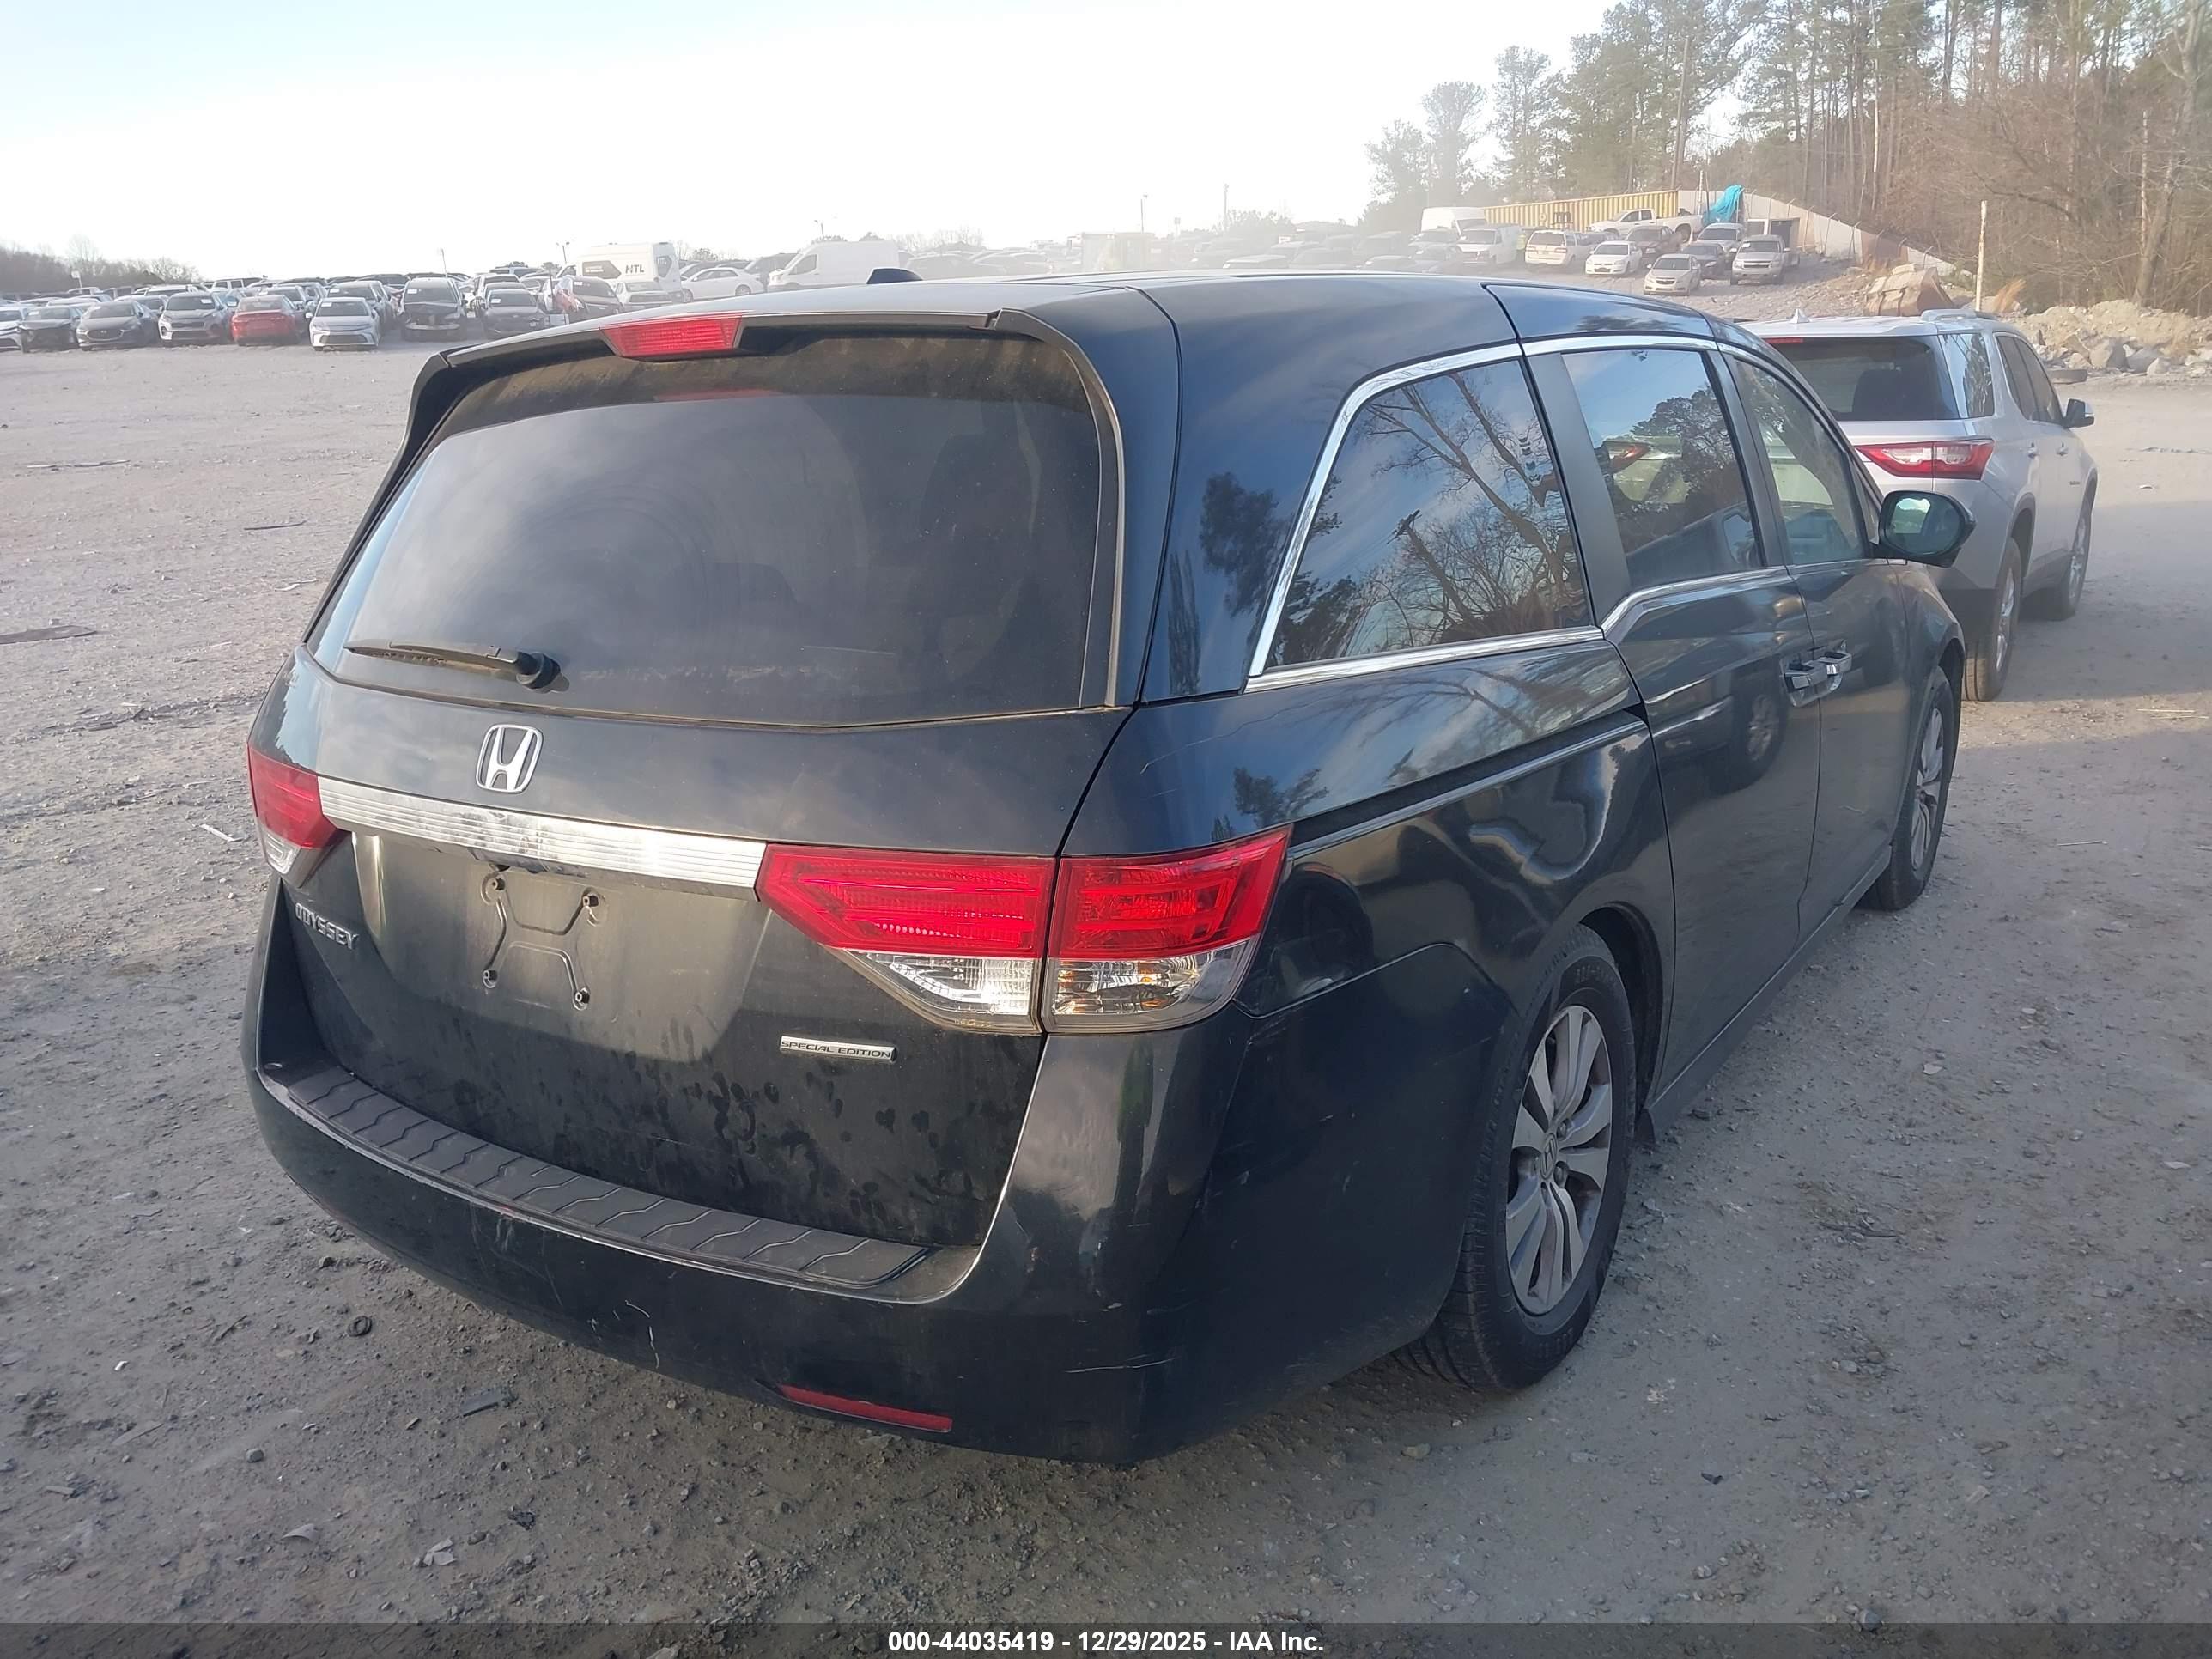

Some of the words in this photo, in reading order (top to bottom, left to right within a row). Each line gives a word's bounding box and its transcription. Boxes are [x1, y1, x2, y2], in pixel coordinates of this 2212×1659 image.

[295, 902, 359, 950] ODYSSEY
[781, 1041, 835, 1053] SPECIAL
[837, 1047, 891, 1058] EDITION
